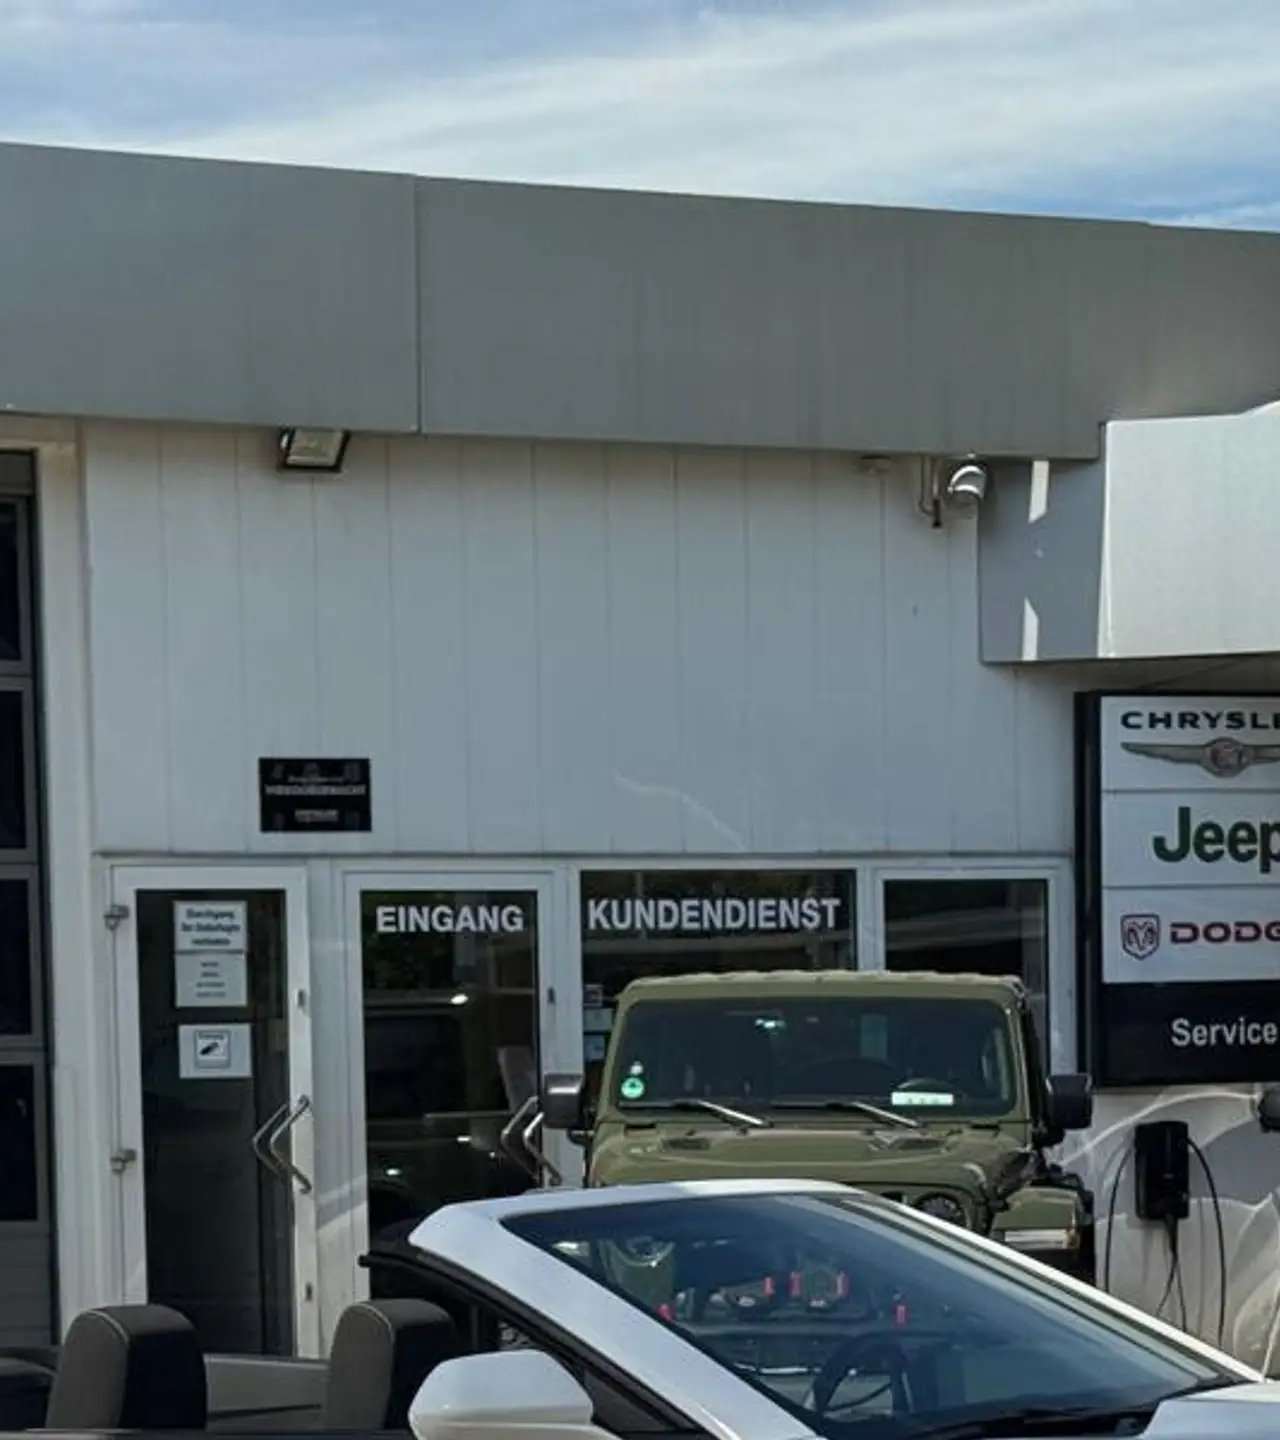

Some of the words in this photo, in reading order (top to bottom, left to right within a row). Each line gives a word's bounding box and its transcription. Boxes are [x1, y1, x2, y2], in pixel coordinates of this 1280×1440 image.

[376, 905, 524, 933] EINGANG
[587, 898, 841, 931] KUNDENDIENST
[1170, 1016, 1280, 1047] Service
